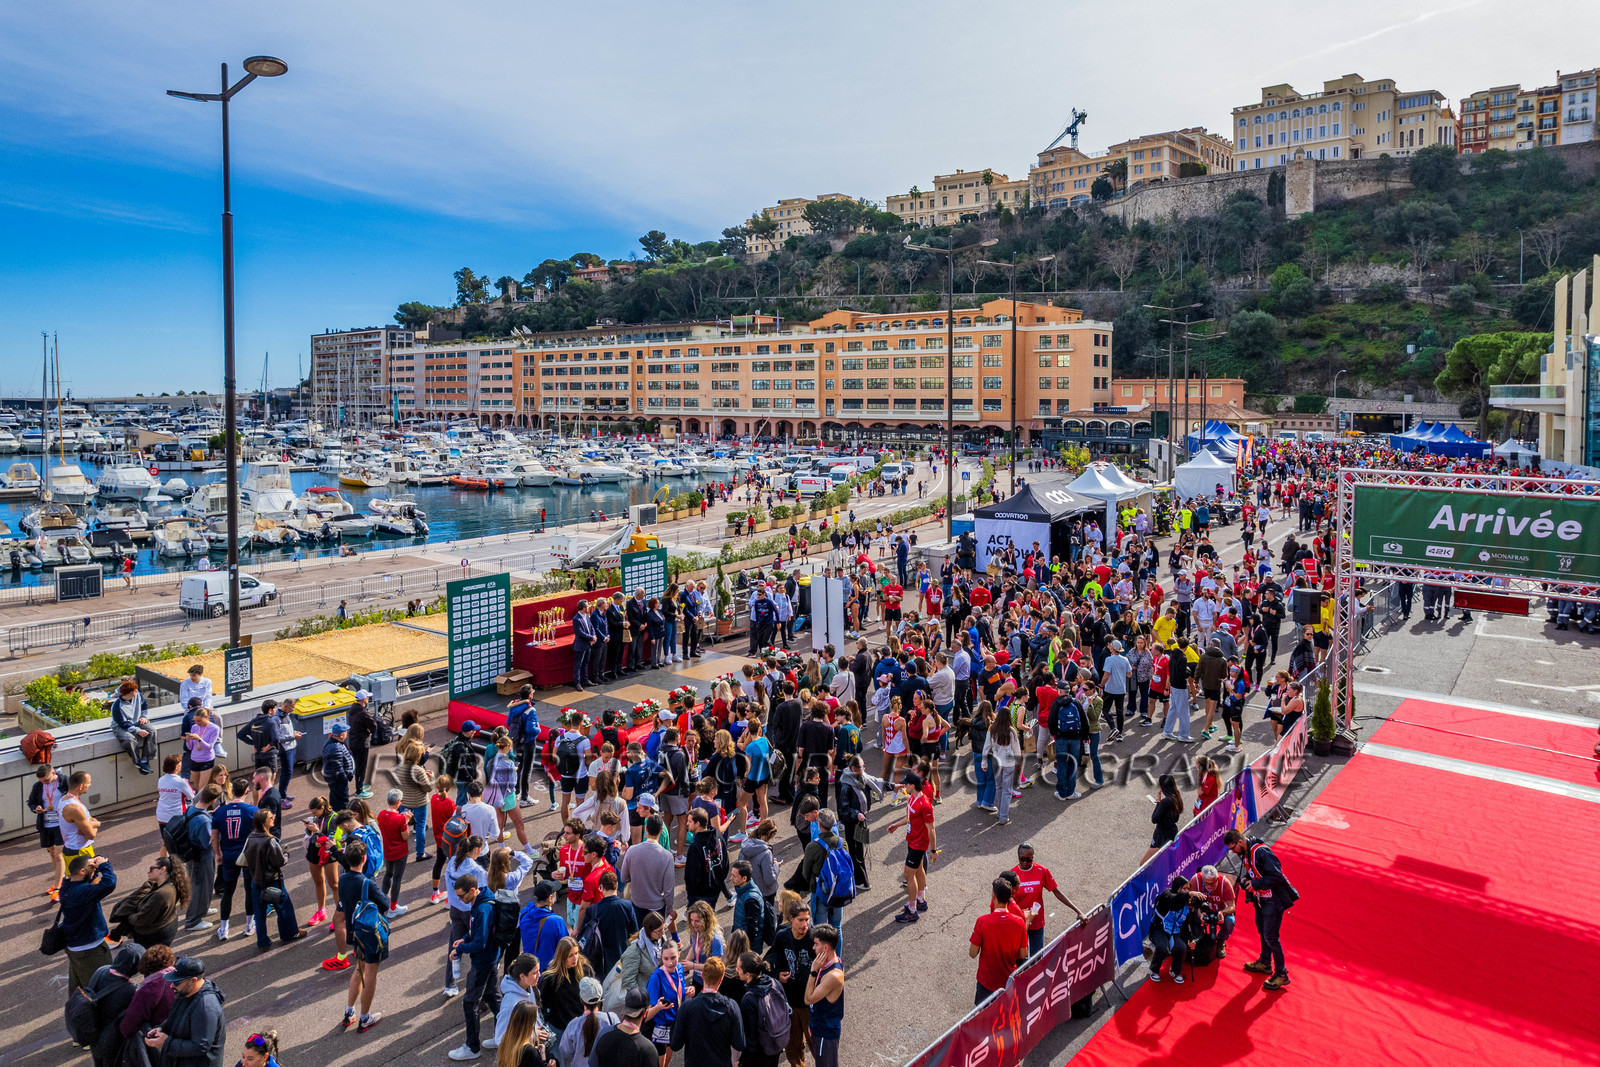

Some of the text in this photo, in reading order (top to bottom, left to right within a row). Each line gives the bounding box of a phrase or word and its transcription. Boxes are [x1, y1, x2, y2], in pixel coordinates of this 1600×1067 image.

[1428, 505, 1582, 541] Arrivée
[988, 534, 1012, 545] ACT
[1428, 548, 1453, 556] 42K
[1491, 552, 1530, 562] MONAFRAIS
[226, 817, 242, 839] 17
[1167, 825, 1228, 885] SHOP SMART, SHOP LOCAL
